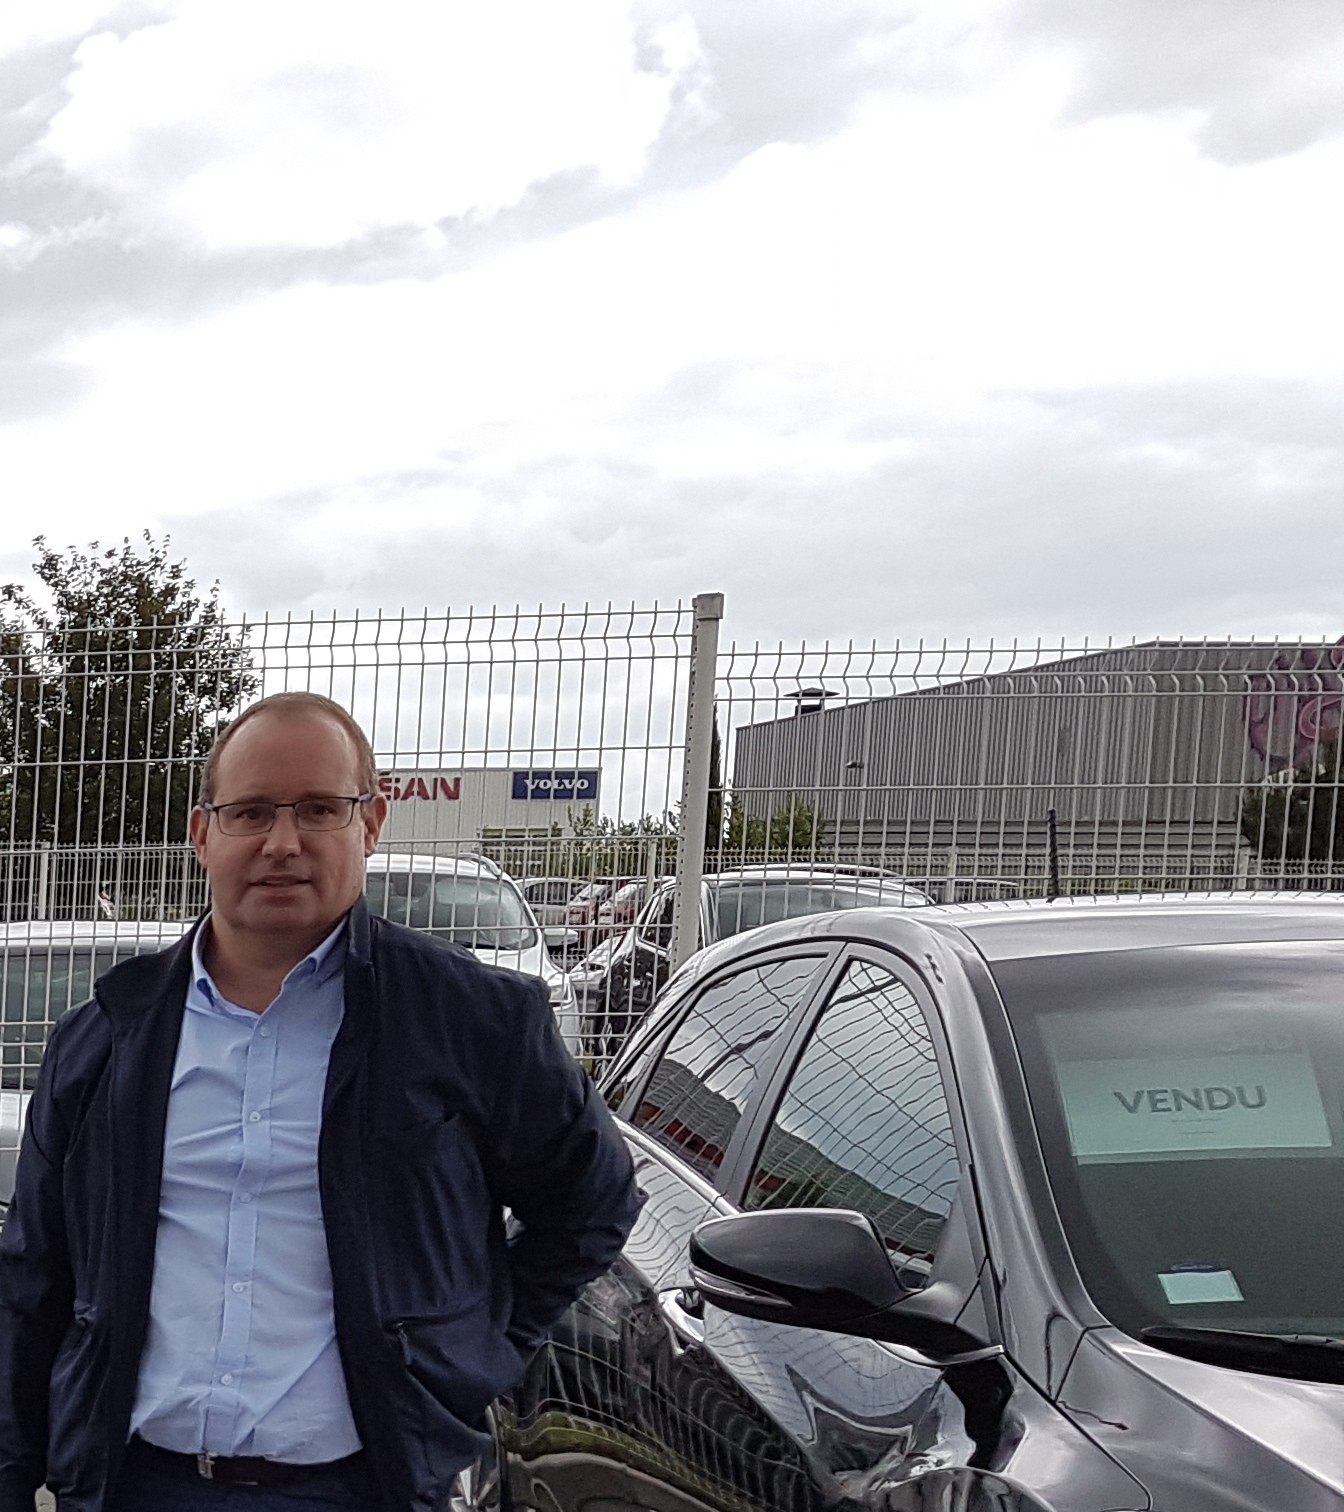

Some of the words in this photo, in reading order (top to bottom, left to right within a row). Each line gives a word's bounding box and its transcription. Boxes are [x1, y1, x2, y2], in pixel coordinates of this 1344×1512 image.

[377, 777, 462, 801] SAN
[524, 778, 589, 791] VOLVO
[1113, 1084, 1268, 1114] VENDU
